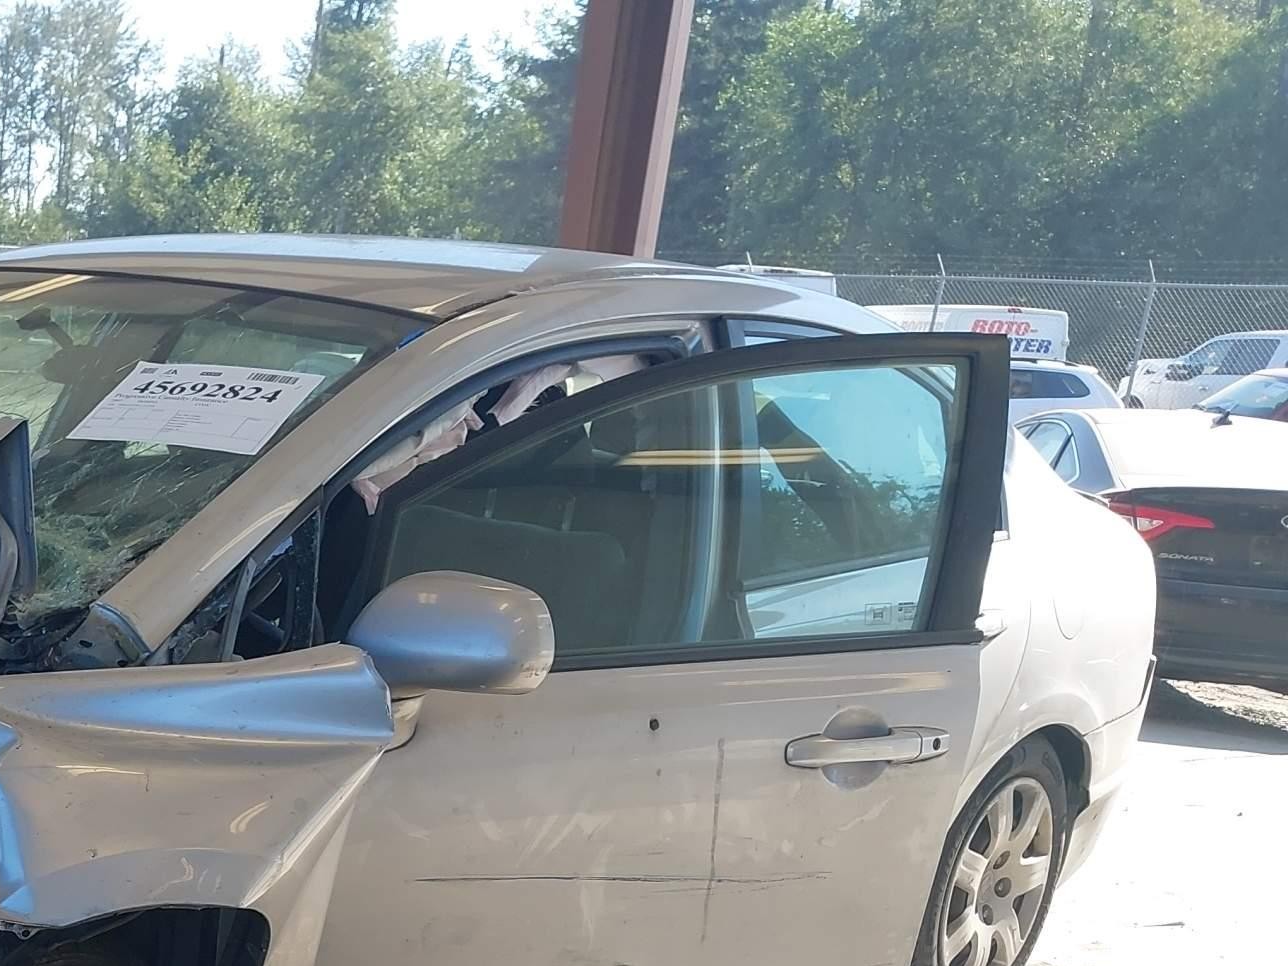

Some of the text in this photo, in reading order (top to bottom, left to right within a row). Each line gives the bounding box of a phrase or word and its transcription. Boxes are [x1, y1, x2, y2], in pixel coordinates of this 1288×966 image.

[971, 319, 1038, 336] ROTO-
[1008, 336, 1052, 354] TER
[133, 379, 283, 403] 45692824
[1158, 551, 1214, 562] SONATA
